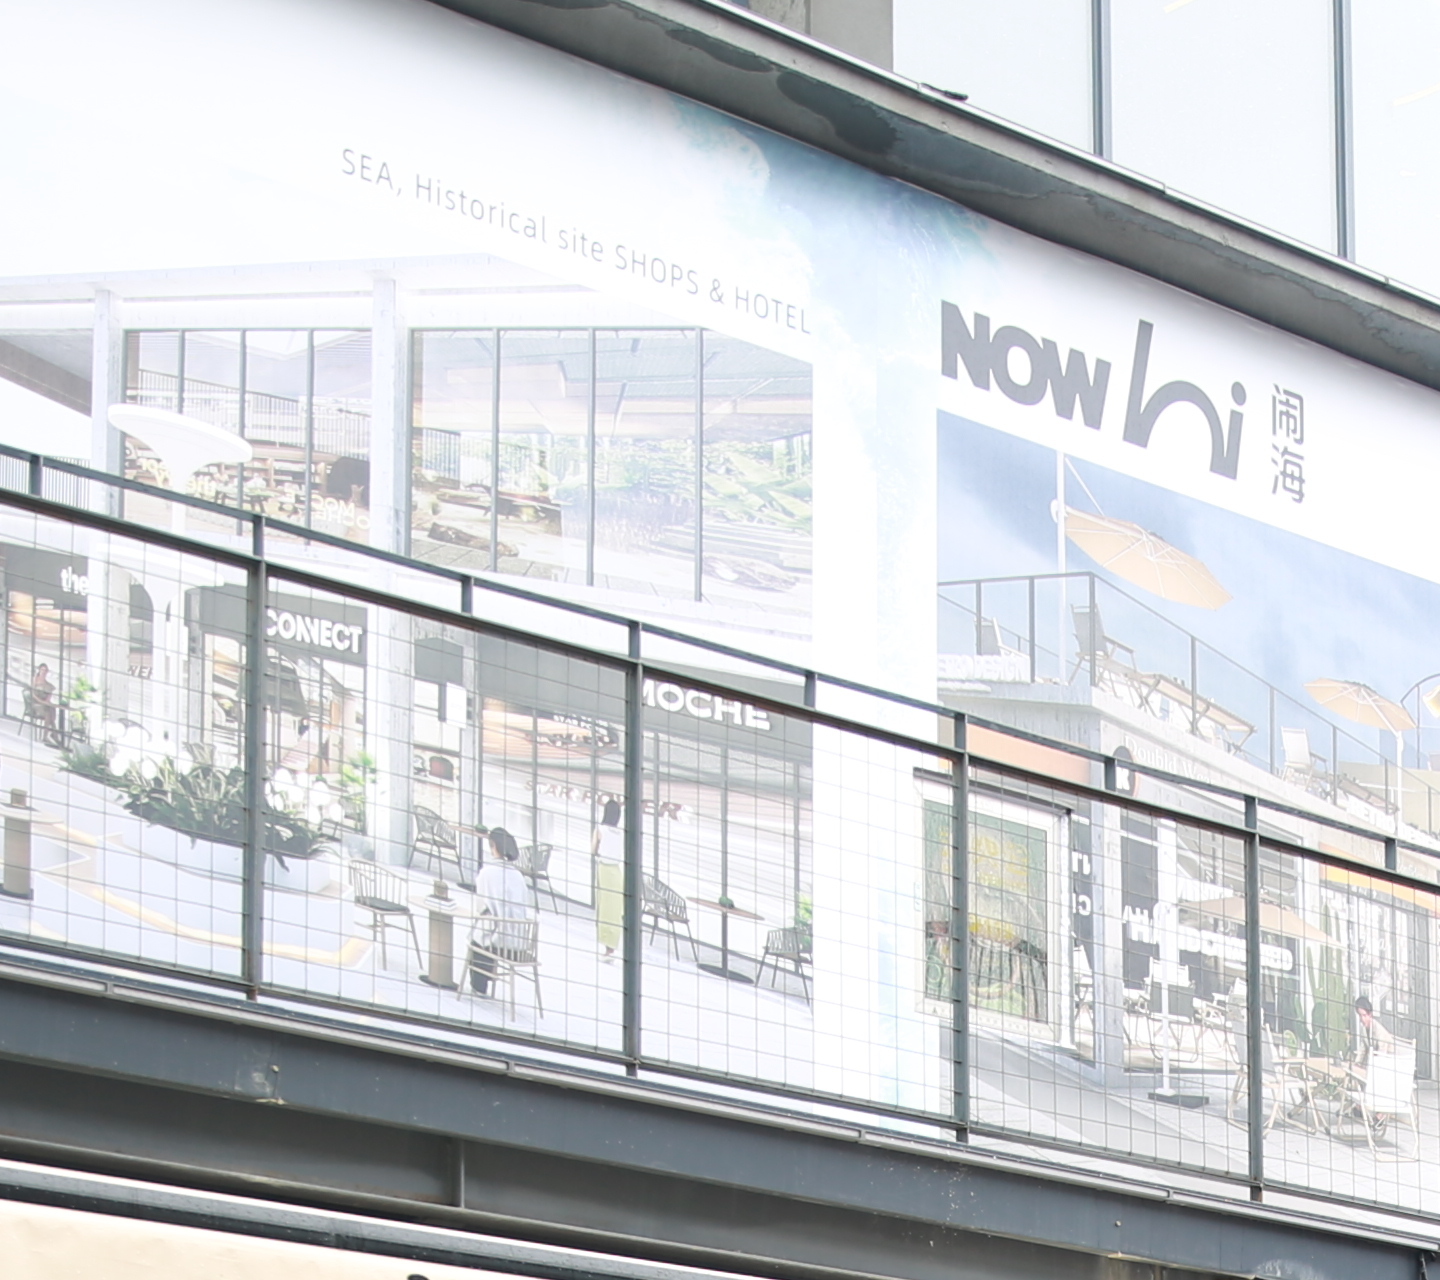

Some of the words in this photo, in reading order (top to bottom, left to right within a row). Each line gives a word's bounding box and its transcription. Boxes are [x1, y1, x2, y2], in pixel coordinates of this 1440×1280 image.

[341, 147, 404, 197] SEA,
[414, 172, 548, 245] Historical
[557, 224, 605, 263] site
[613, 243, 700, 296] SHOPS
[707, 277, 726, 306] &
[732, 285, 811, 335] HOTEL
[940, 298, 1112, 431] NOW
[1270, 382, 1306, 504] 闹海
[264, 608, 363, 654] CONNECT
